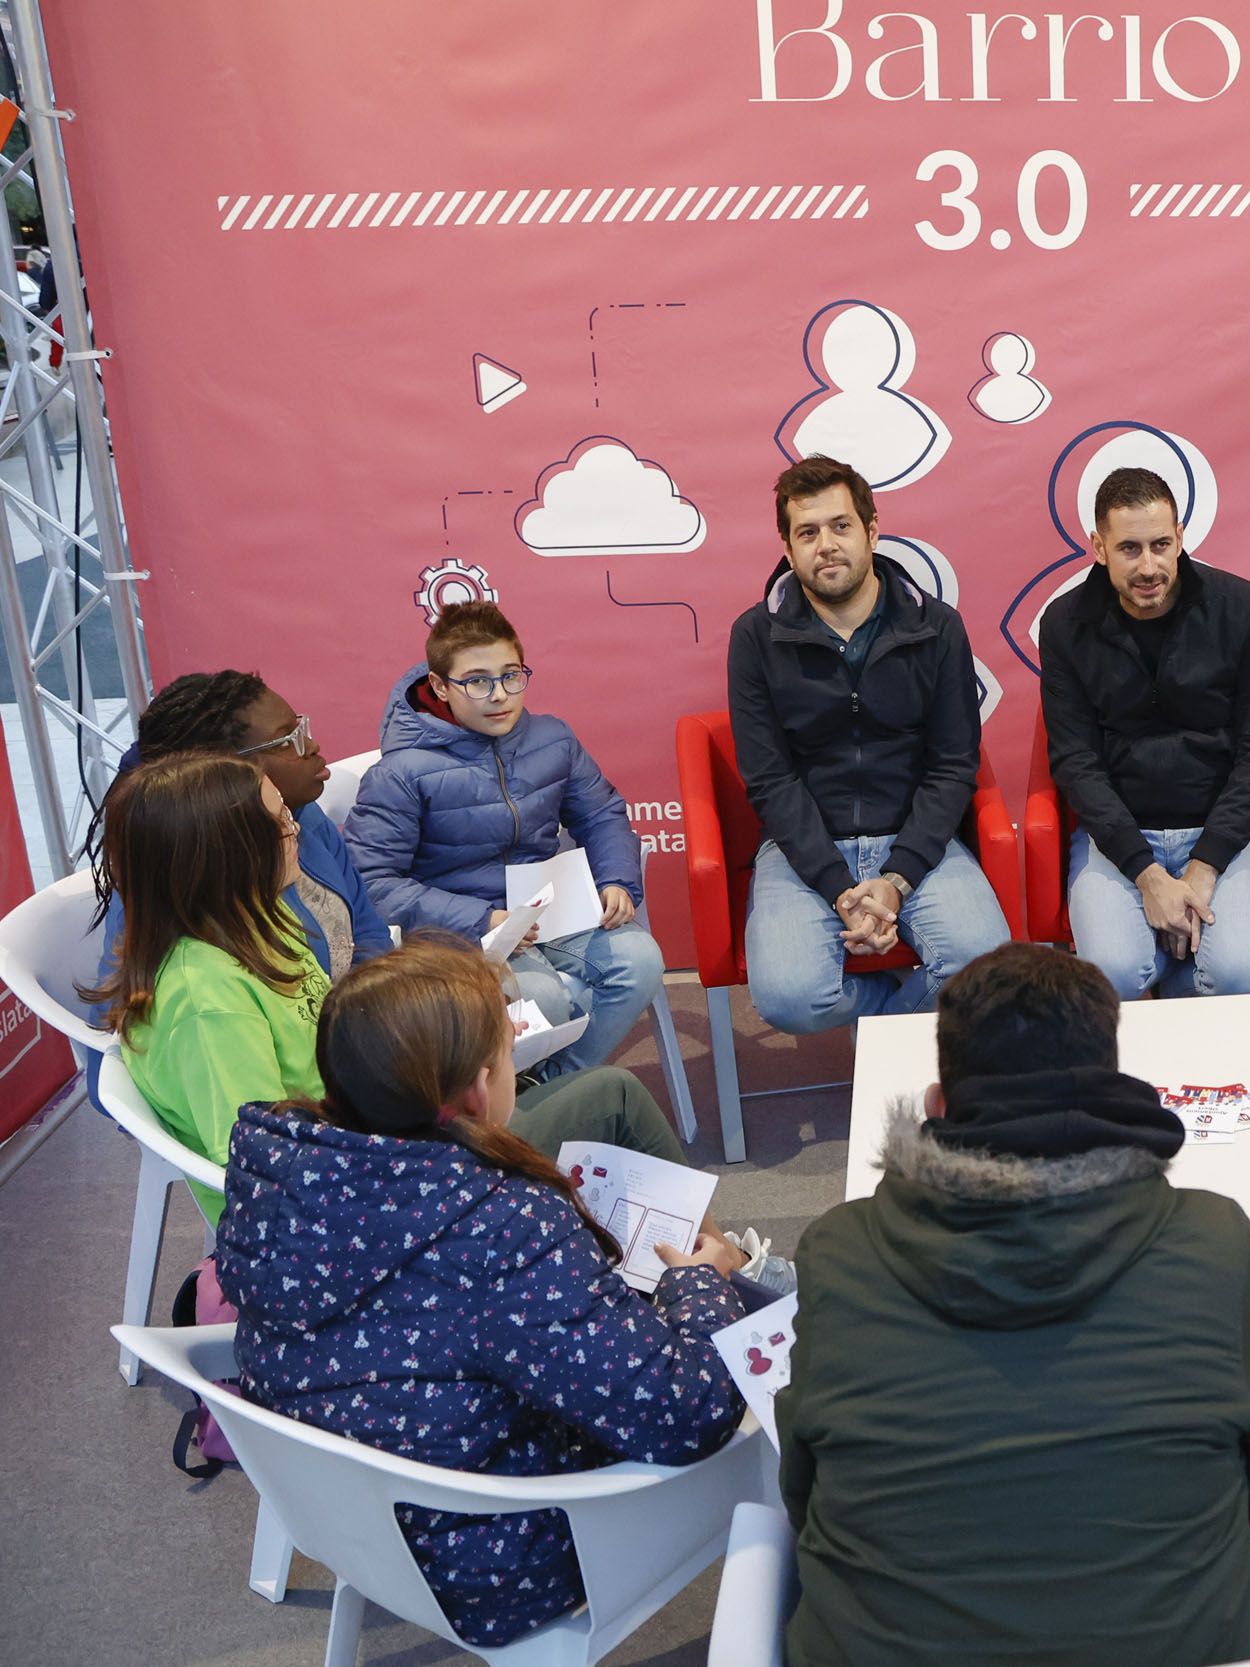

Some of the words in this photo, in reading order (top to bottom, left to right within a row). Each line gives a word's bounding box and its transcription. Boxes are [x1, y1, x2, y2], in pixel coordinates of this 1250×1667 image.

[749, 0, 1241, 102] Barrio
[914, 149, 1088, 251] 3.0
[632, 830, 686, 852] ata
